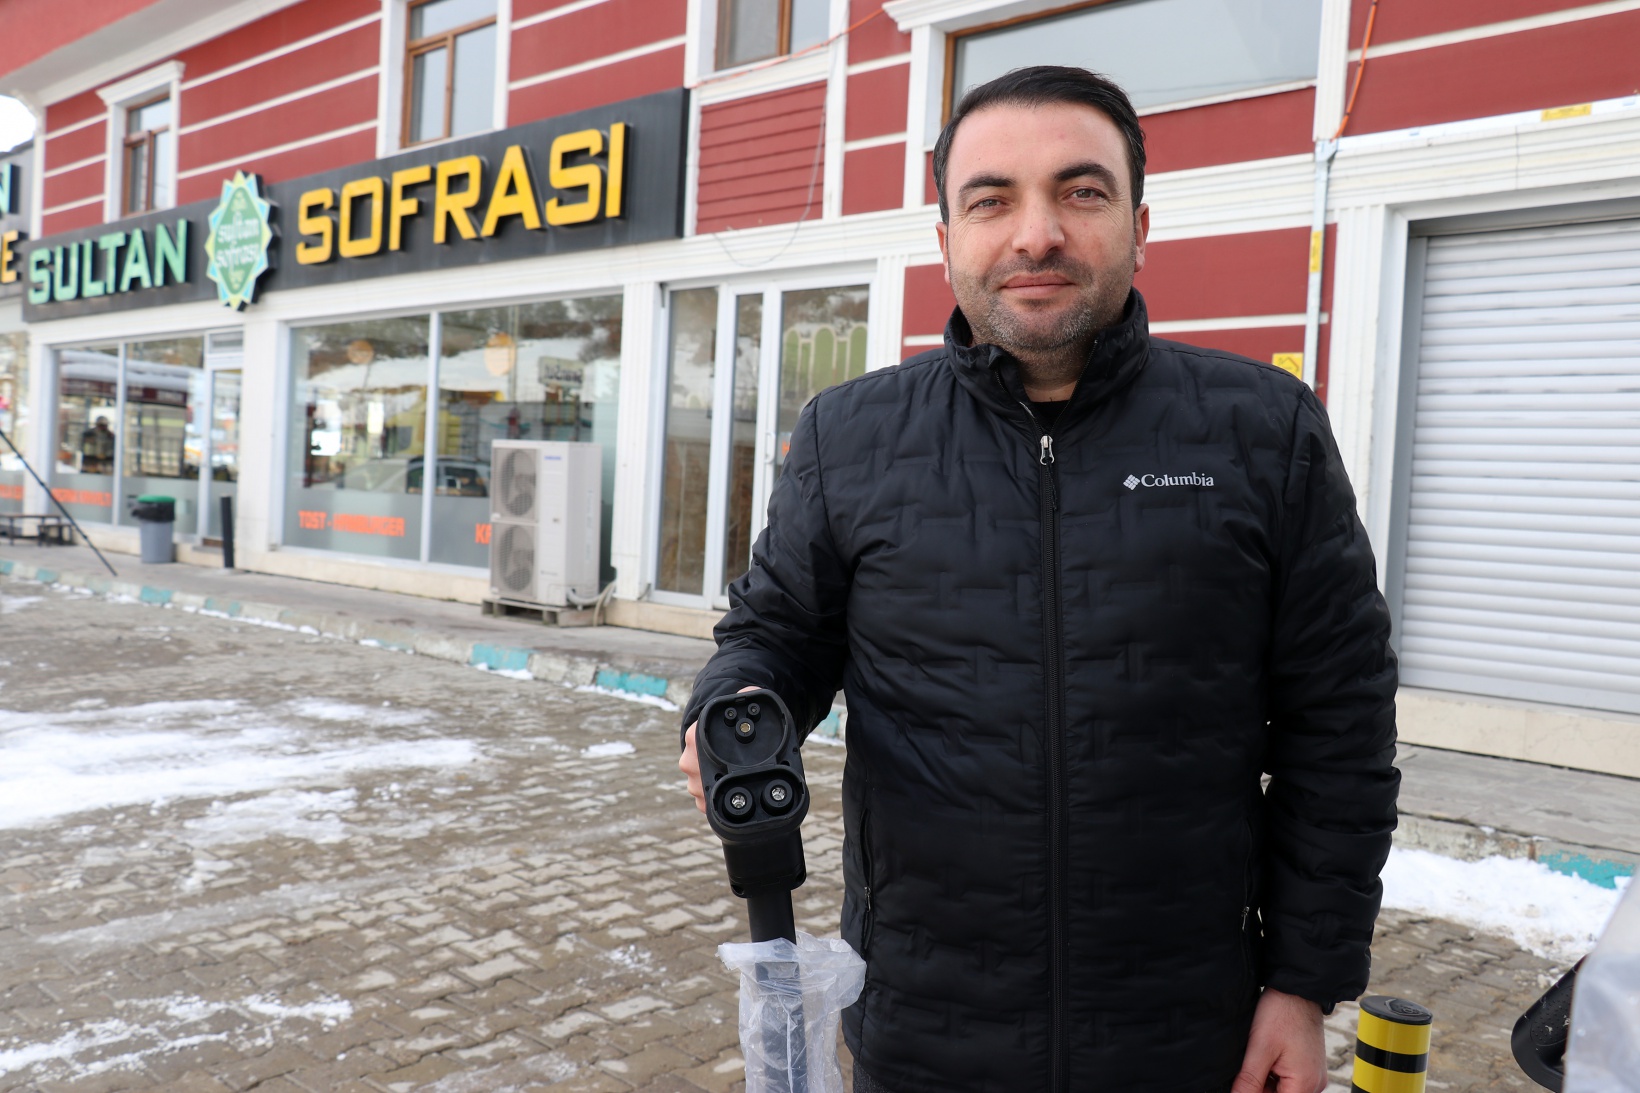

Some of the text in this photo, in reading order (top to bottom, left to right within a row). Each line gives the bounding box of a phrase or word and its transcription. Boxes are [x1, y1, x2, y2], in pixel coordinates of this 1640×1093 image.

[28, 122, 626, 305] SULTAN SOFRASI
[1140, 471, 1215, 487] Columbia
